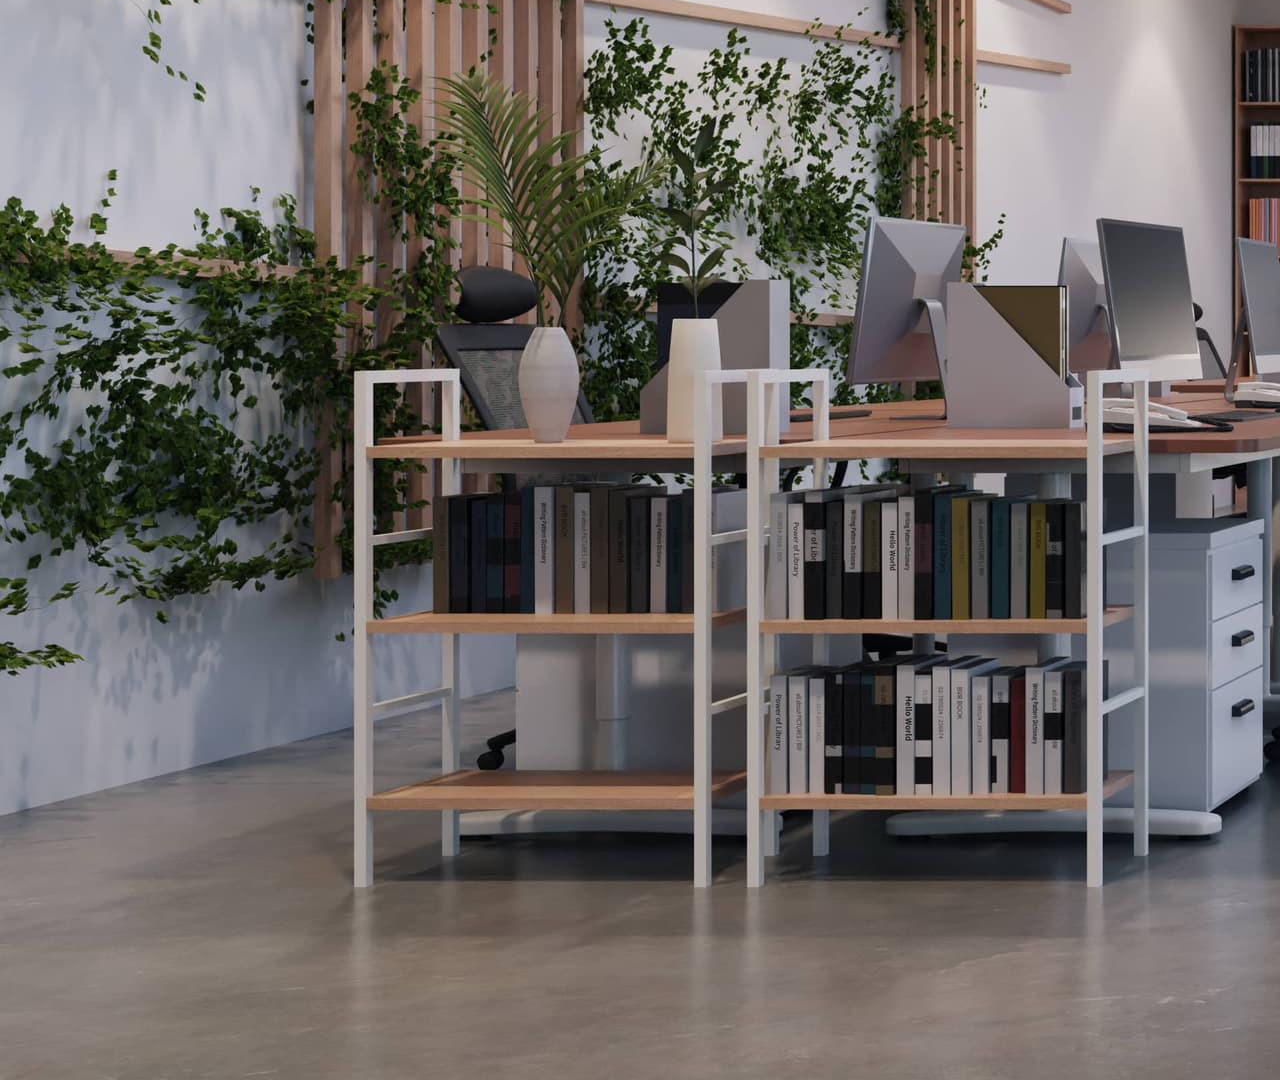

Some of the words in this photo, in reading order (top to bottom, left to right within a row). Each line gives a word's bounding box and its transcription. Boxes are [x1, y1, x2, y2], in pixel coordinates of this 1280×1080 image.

[849, 545, 857, 570] Dictionary
[903, 547, 911, 571] Dictionary
[775, 726, 783, 751] Library
[1031, 720, 1039, 744] Dictionary
